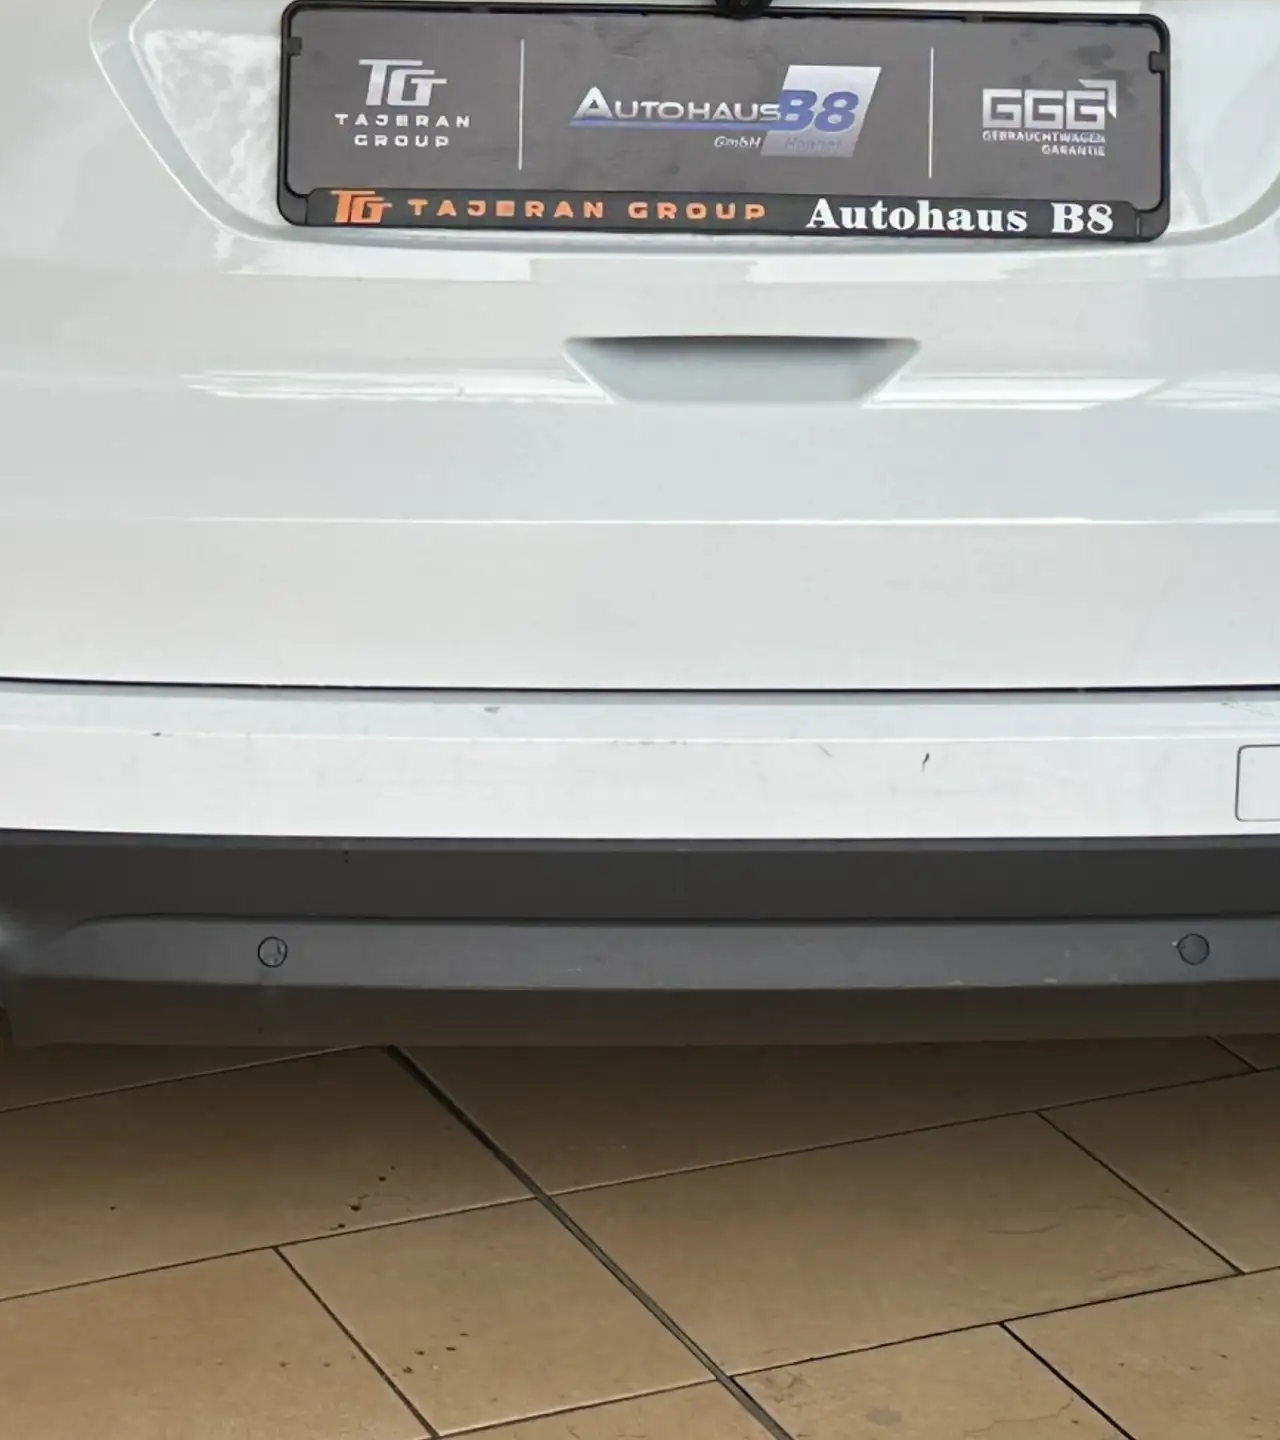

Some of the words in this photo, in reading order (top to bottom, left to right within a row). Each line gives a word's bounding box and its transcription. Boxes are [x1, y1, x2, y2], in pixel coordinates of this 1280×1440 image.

[358, 58, 448, 107] TG
[334, 113, 470, 128] TAJERAN
[774, 89, 859, 132] B8
[982, 88, 1105, 129] GGG
[353, 134, 449, 148] GROUP
[713, 135, 763, 150] GmbH
[1041, 144, 1106, 157] GARANTIE
[329, 190, 393, 224] TG
[407, 198, 604, 220] TAJERAN
[627, 201, 766, 221] GROUP
[804, 197, 1029, 233] Autohaus
[1050, 202, 1114, 235] B8
